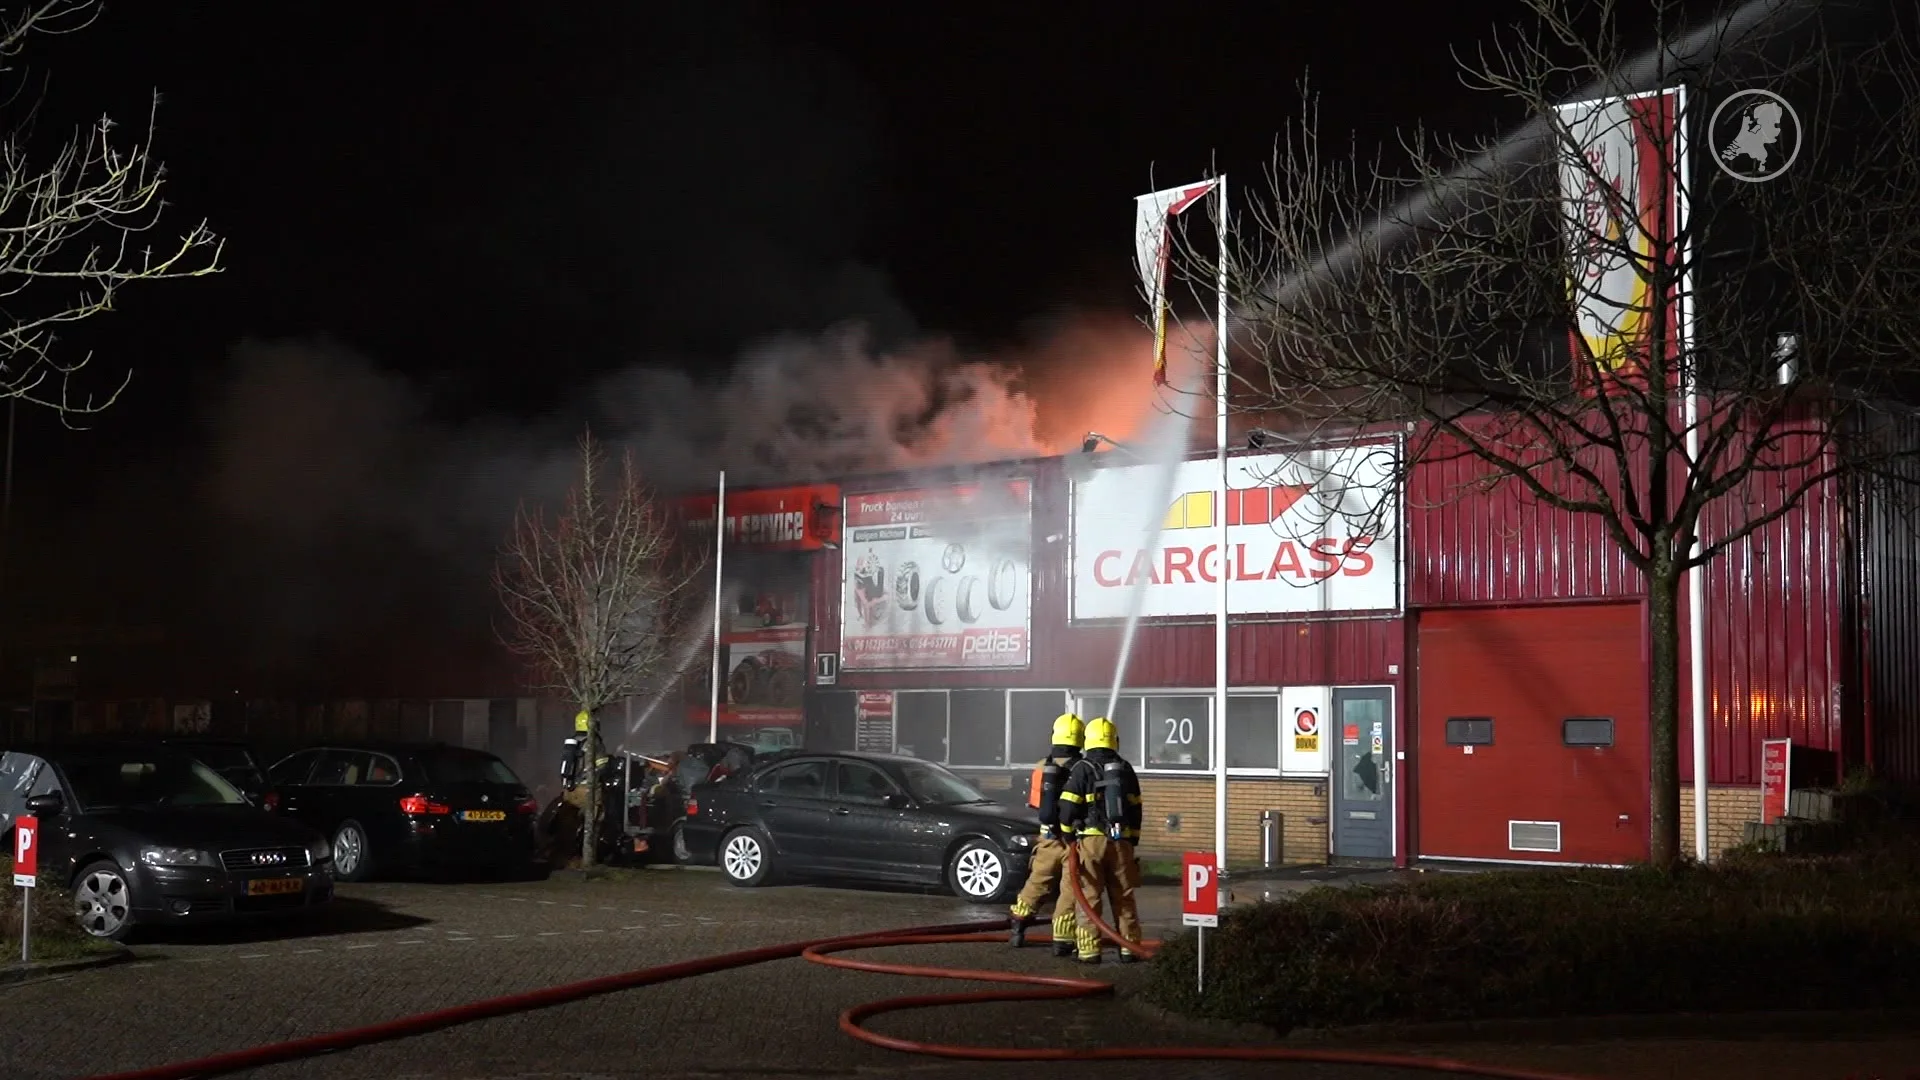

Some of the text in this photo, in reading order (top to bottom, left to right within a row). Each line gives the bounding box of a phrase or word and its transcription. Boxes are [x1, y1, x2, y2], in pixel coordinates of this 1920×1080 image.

[741, 500, 804, 544] service
[860, 502, 884, 513] Truck
[890, 511, 902, 522] 24
[1093, 536, 1374, 587] CARGLASS
[962, 630, 1021, 659] petlas
[1165, 718, 1193, 744] 20
[1296, 738, 1316, 749] BOVAG
[18, 827, 32, 863] P
[1188, 864, 1209, 902] P
